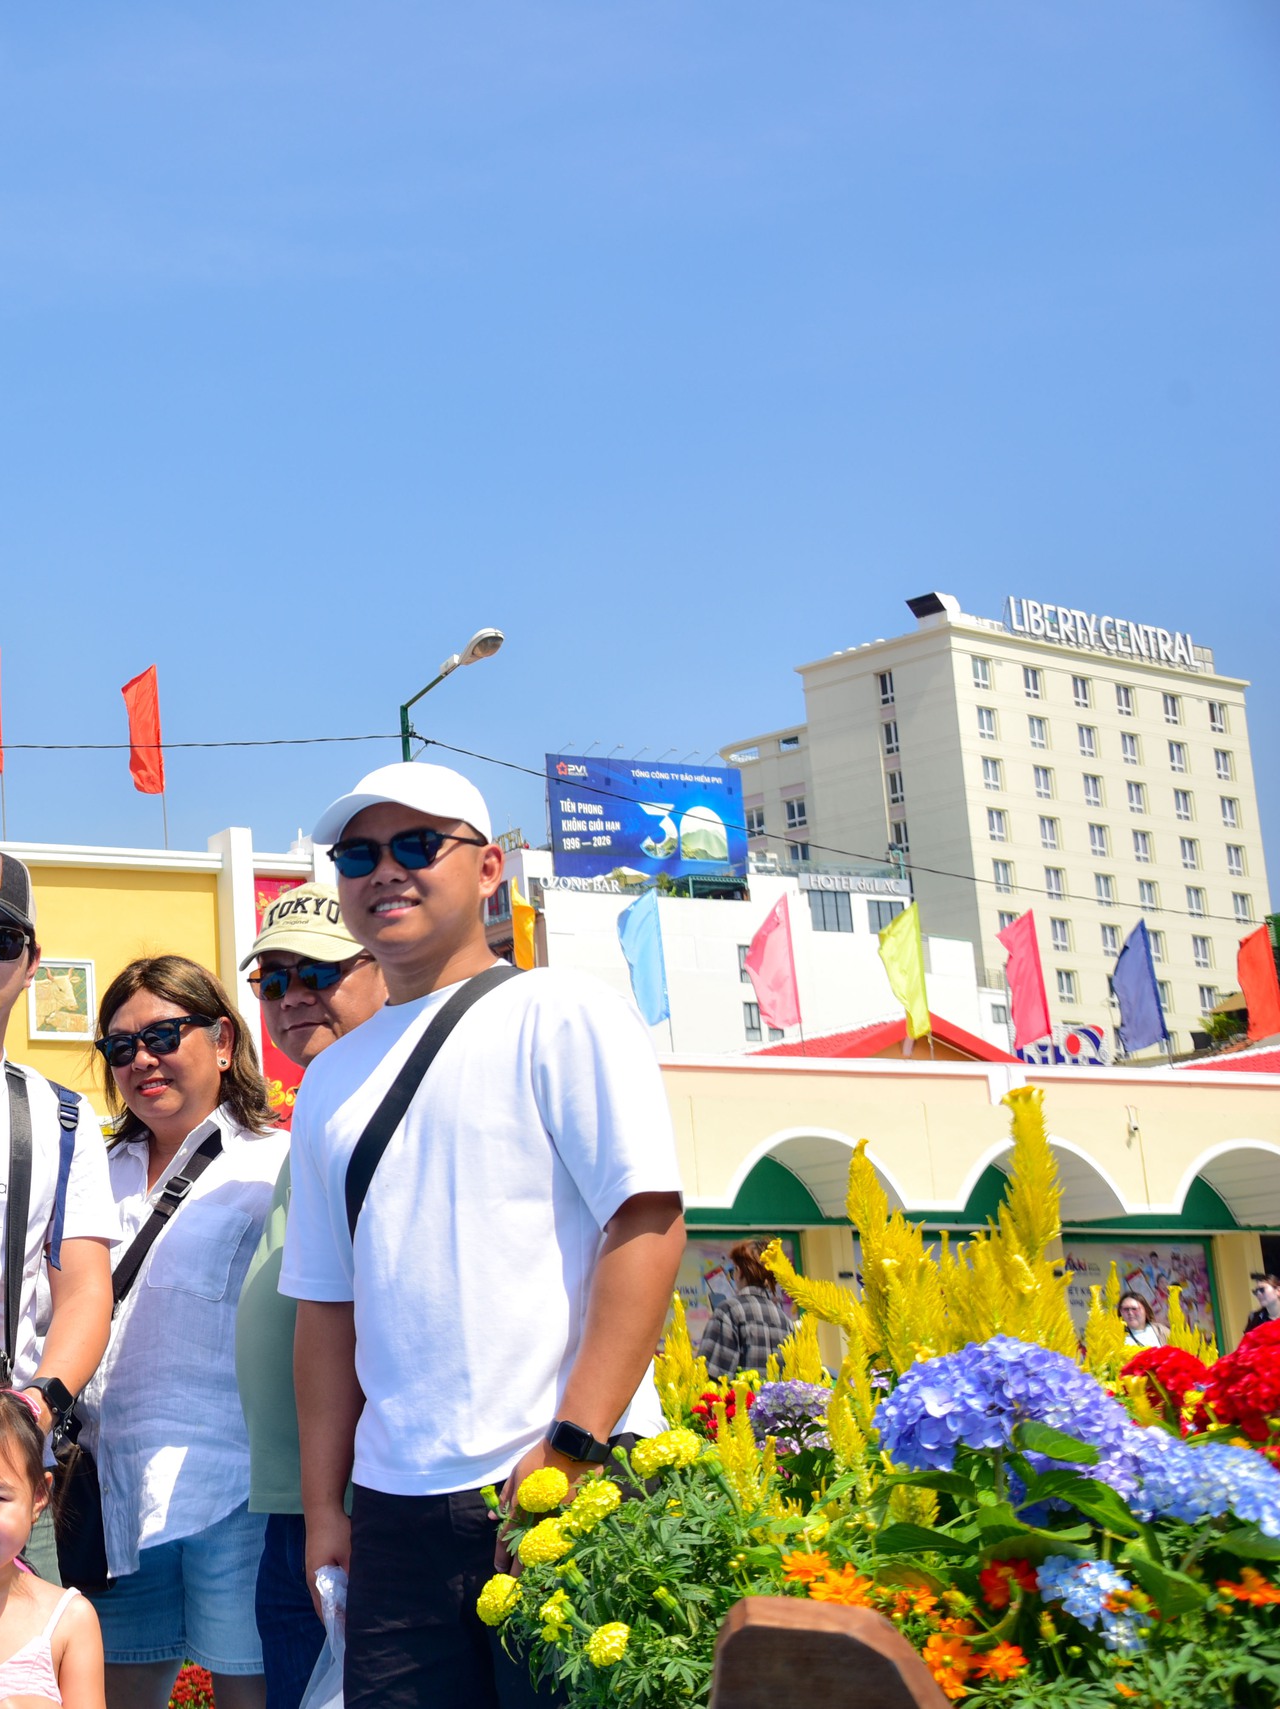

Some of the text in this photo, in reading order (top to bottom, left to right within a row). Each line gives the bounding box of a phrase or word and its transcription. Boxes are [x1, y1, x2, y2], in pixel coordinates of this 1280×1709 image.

[1009, 596, 1202, 667] LIBERTY CENTRAL
[567, 764, 588, 777] PVI
[650, 771, 670, 780] CÔNG
[577, 802, 604, 816] PHONG
[562, 817, 588, 831] KHÔNG
[605, 821, 621, 833] HẠN
[637, 802, 730, 864] 30
[563, 837, 581, 850] 1996
[592, 835, 612, 847] 2026
[540, 876, 621, 893] OZONE BAR
[809, 874, 858, 892] HOTEL
[874, 879, 900, 894] LAC
[268, 897, 340, 927] TOKYO
